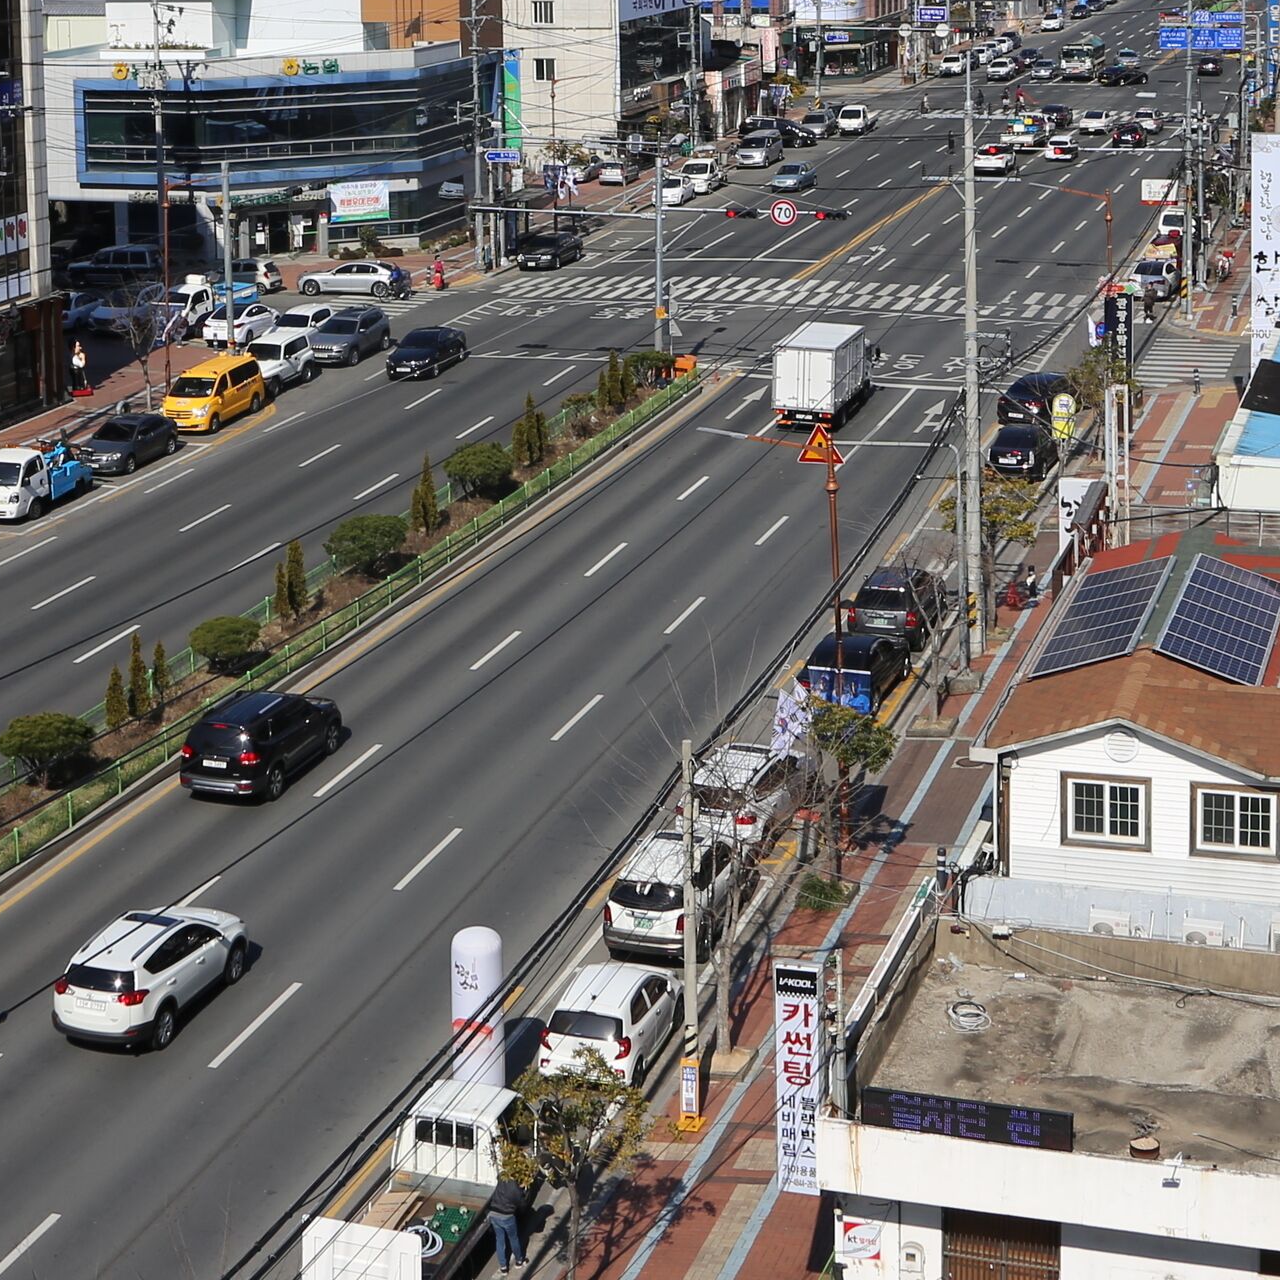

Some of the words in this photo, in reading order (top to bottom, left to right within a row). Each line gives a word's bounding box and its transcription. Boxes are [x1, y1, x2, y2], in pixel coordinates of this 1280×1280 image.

[303, 58, 339, 76] 농협
[775, 207, 791, 219] 70
[779, 977, 814, 989] V-KOOL
[782, 1003, 814, 1088] 카썬팅
[781, 1095, 797, 1158] 네비매립
[799, 1096, 817, 1159] 블랙박스
[848, 1235, 858, 1244] kt
